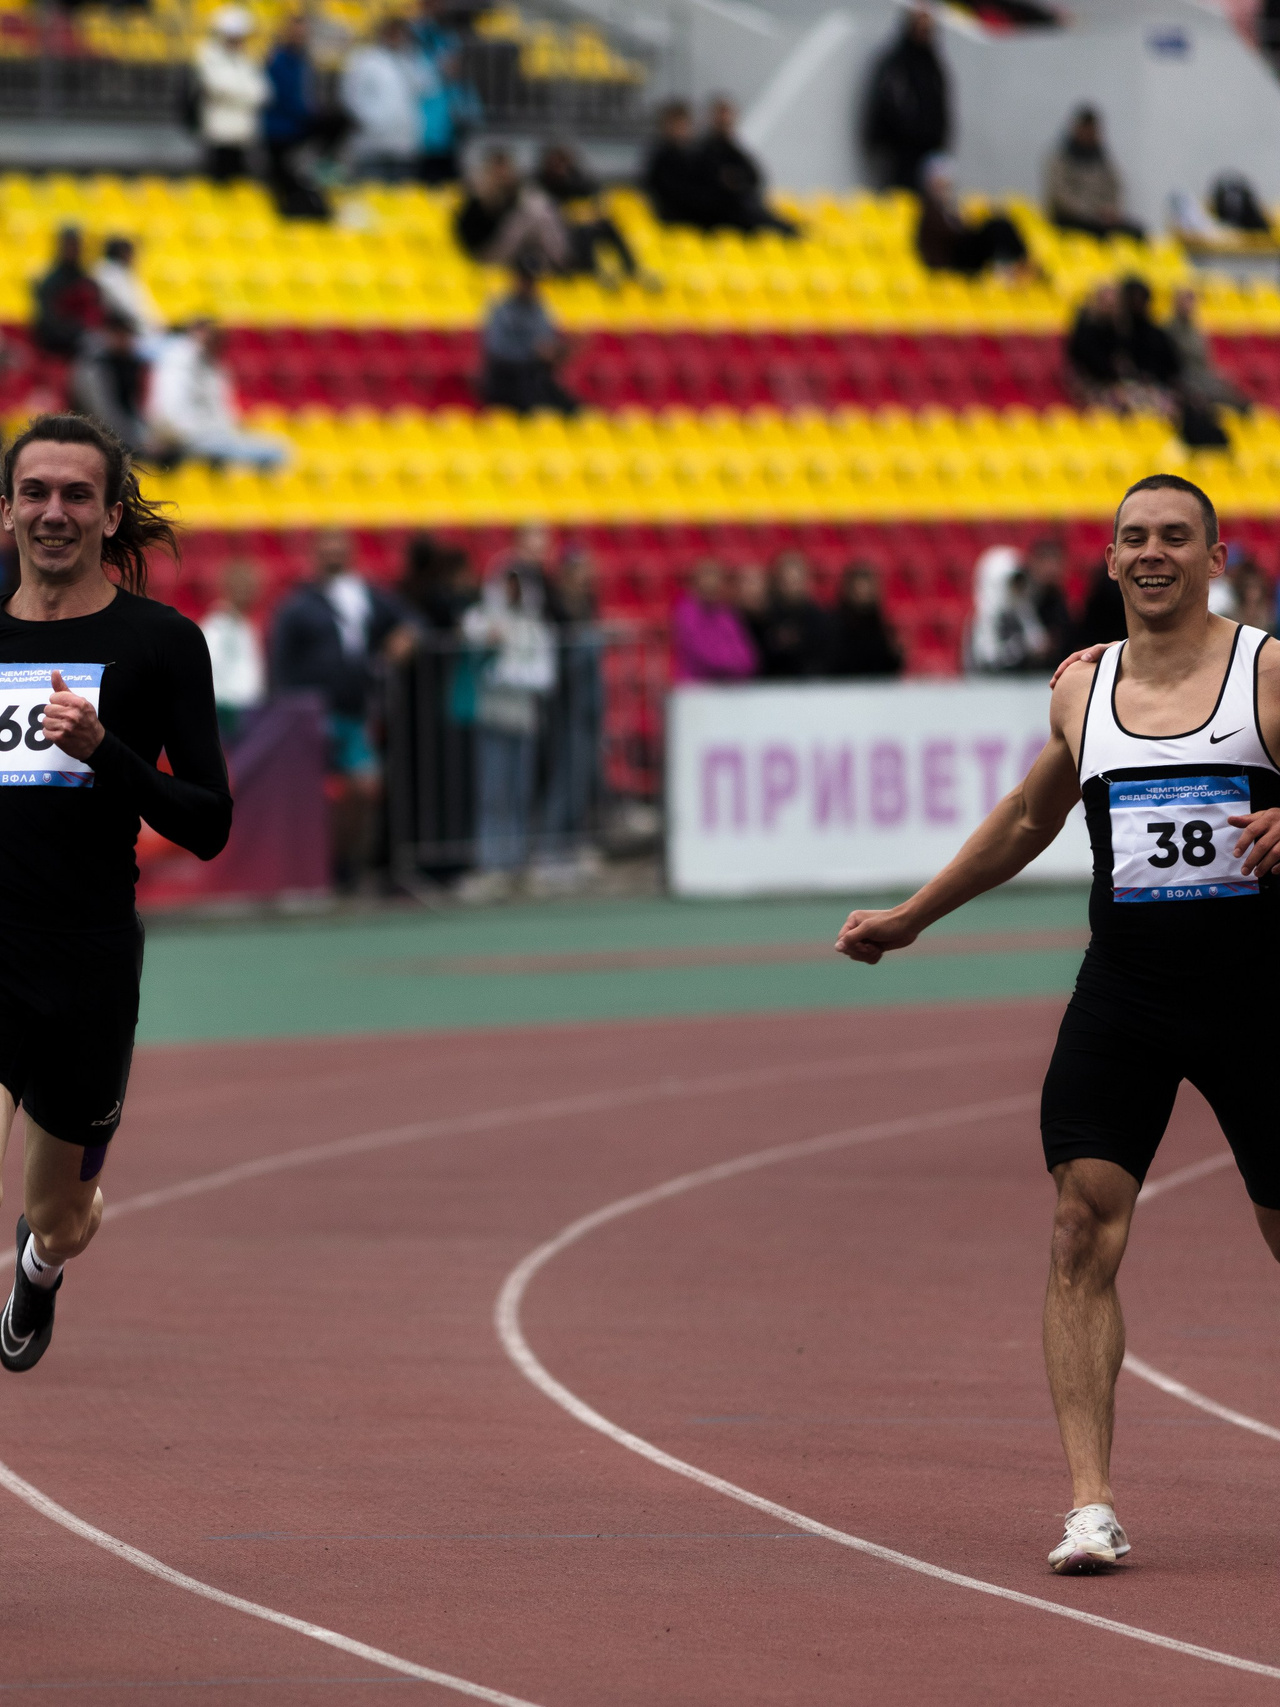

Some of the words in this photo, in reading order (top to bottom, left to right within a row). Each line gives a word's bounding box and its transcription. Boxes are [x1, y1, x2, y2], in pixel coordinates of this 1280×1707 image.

[0, 669, 64, 677] ЧЕМПИОНТ
[1, 773, 36, 784] ВФЛА
[698, 738, 1050, 834] ПРИВЕТ
[1145, 784, 1209, 793] ЧЕМПИОНАТ
[1147, 820, 1217, 868] 38
[1166, 888, 1203, 899] ВФЛА
